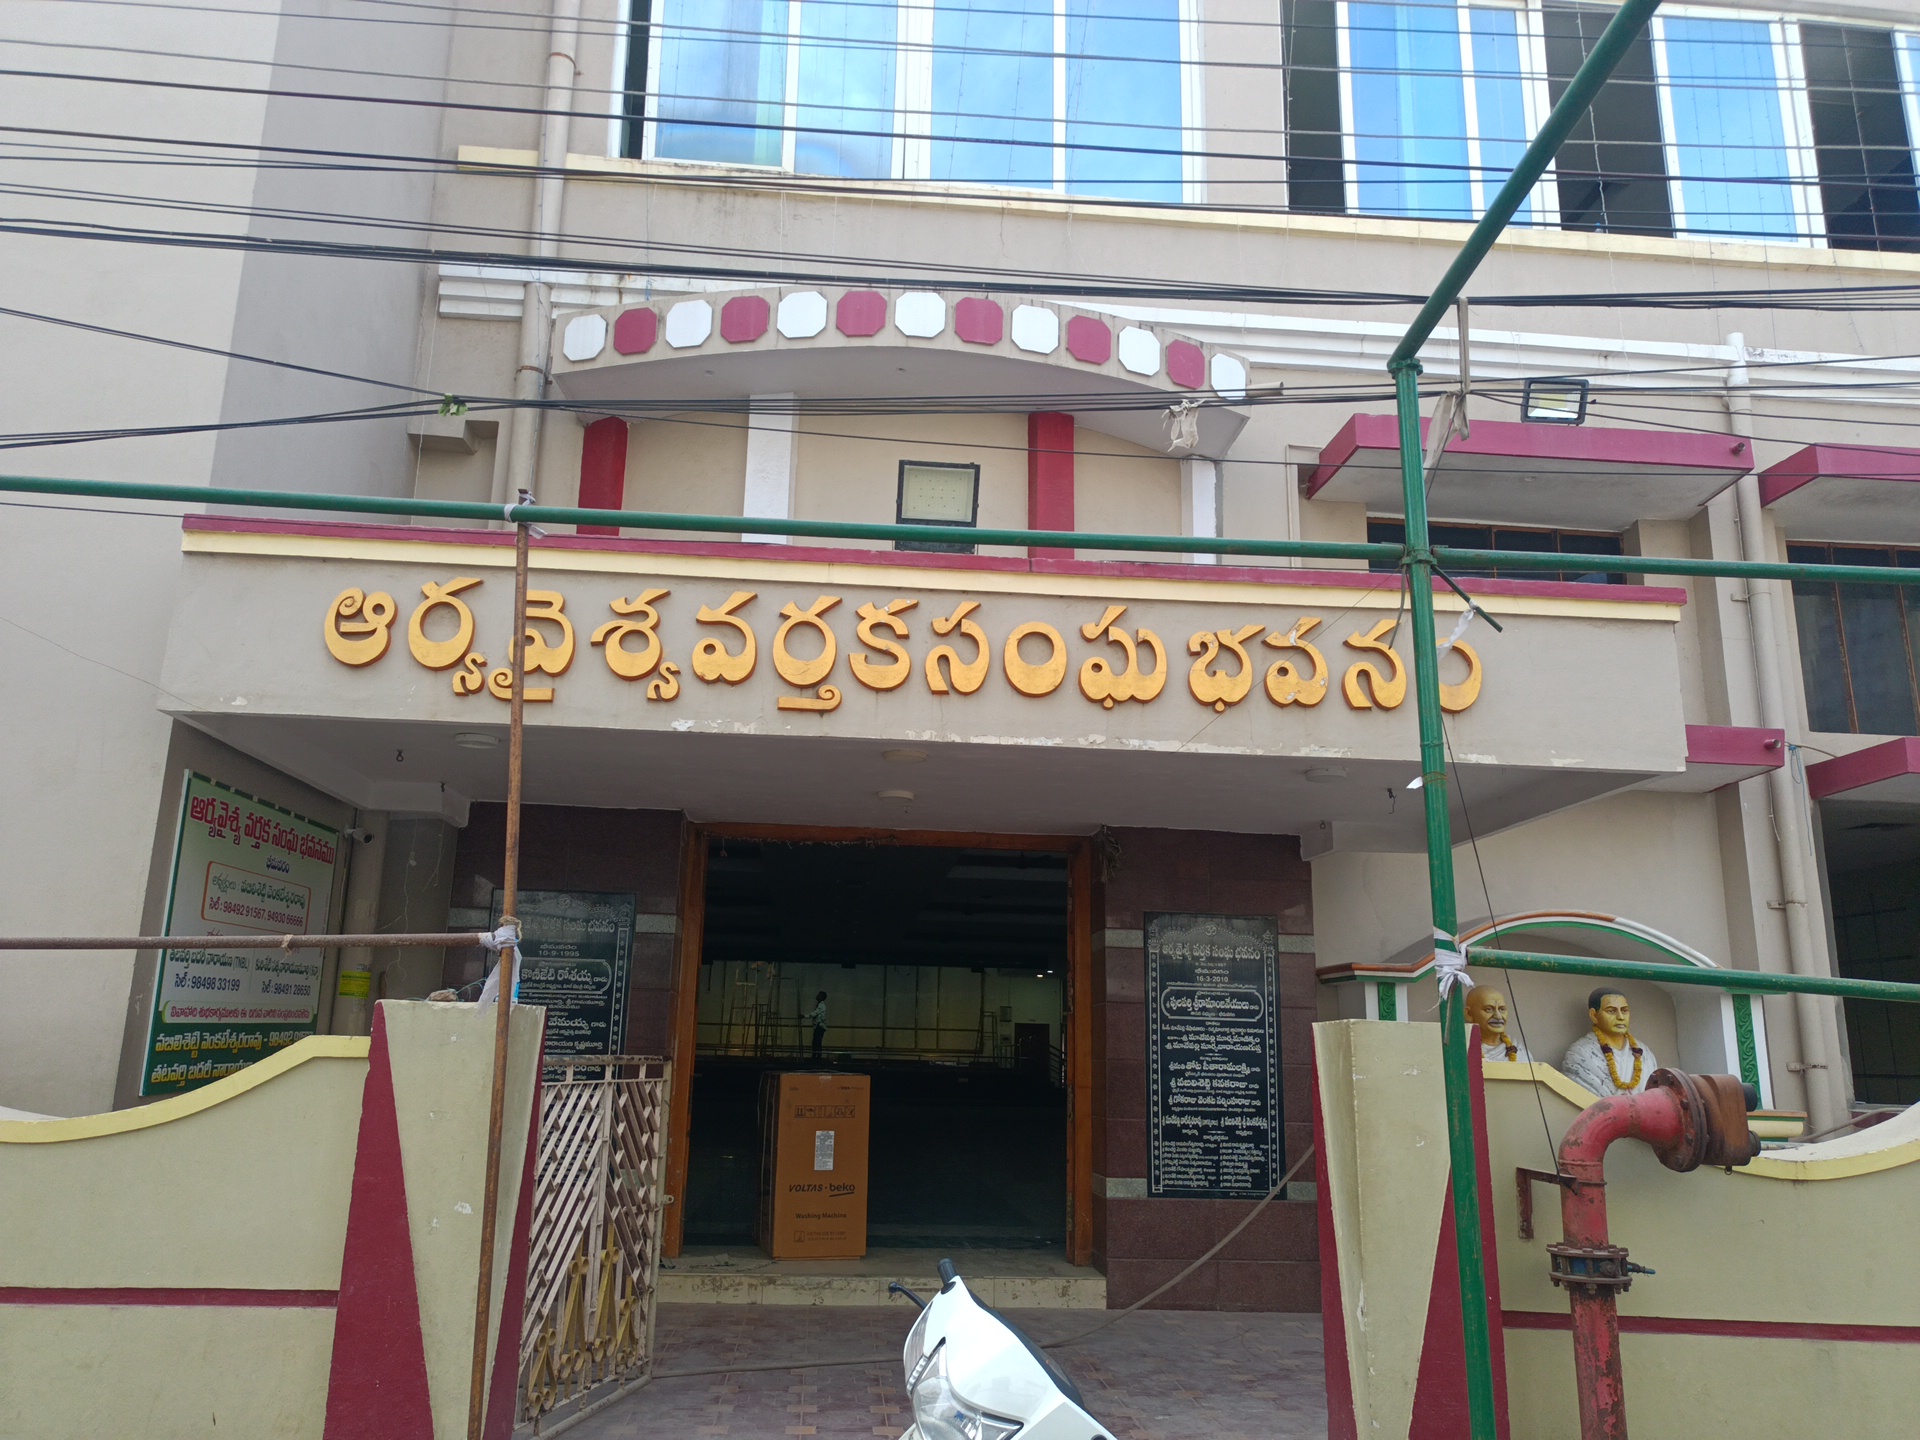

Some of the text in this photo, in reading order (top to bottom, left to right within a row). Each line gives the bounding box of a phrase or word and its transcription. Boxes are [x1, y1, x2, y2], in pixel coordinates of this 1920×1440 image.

[190, 796, 335, 865] ఆర్యవైశ్య వర్తక సంఘ భవనము
[223, 900, 245, 916] 98492
[267, 909, 286, 924] 94930
[286, 911, 304, 927] 66666
[1162, 943, 1261, 961] ఆర్యవైశ్య వర్తక సంఘ భవనం
[191, 975, 216, 991] 98498
[216, 978, 241, 992] 33199
[557, 968, 593, 984] రోశయ్య
[274, 983, 292, 996] 98491
[292, 984, 311, 997] 28650
[201, 1028, 263, 1054] వెంకటేశ్వరరావు
[151, 1062, 187, 1087] తటవర్తి
[789, 1183, 856, 1192] VOLTAS beko
[795, 1212, 821, 1220] Washing
